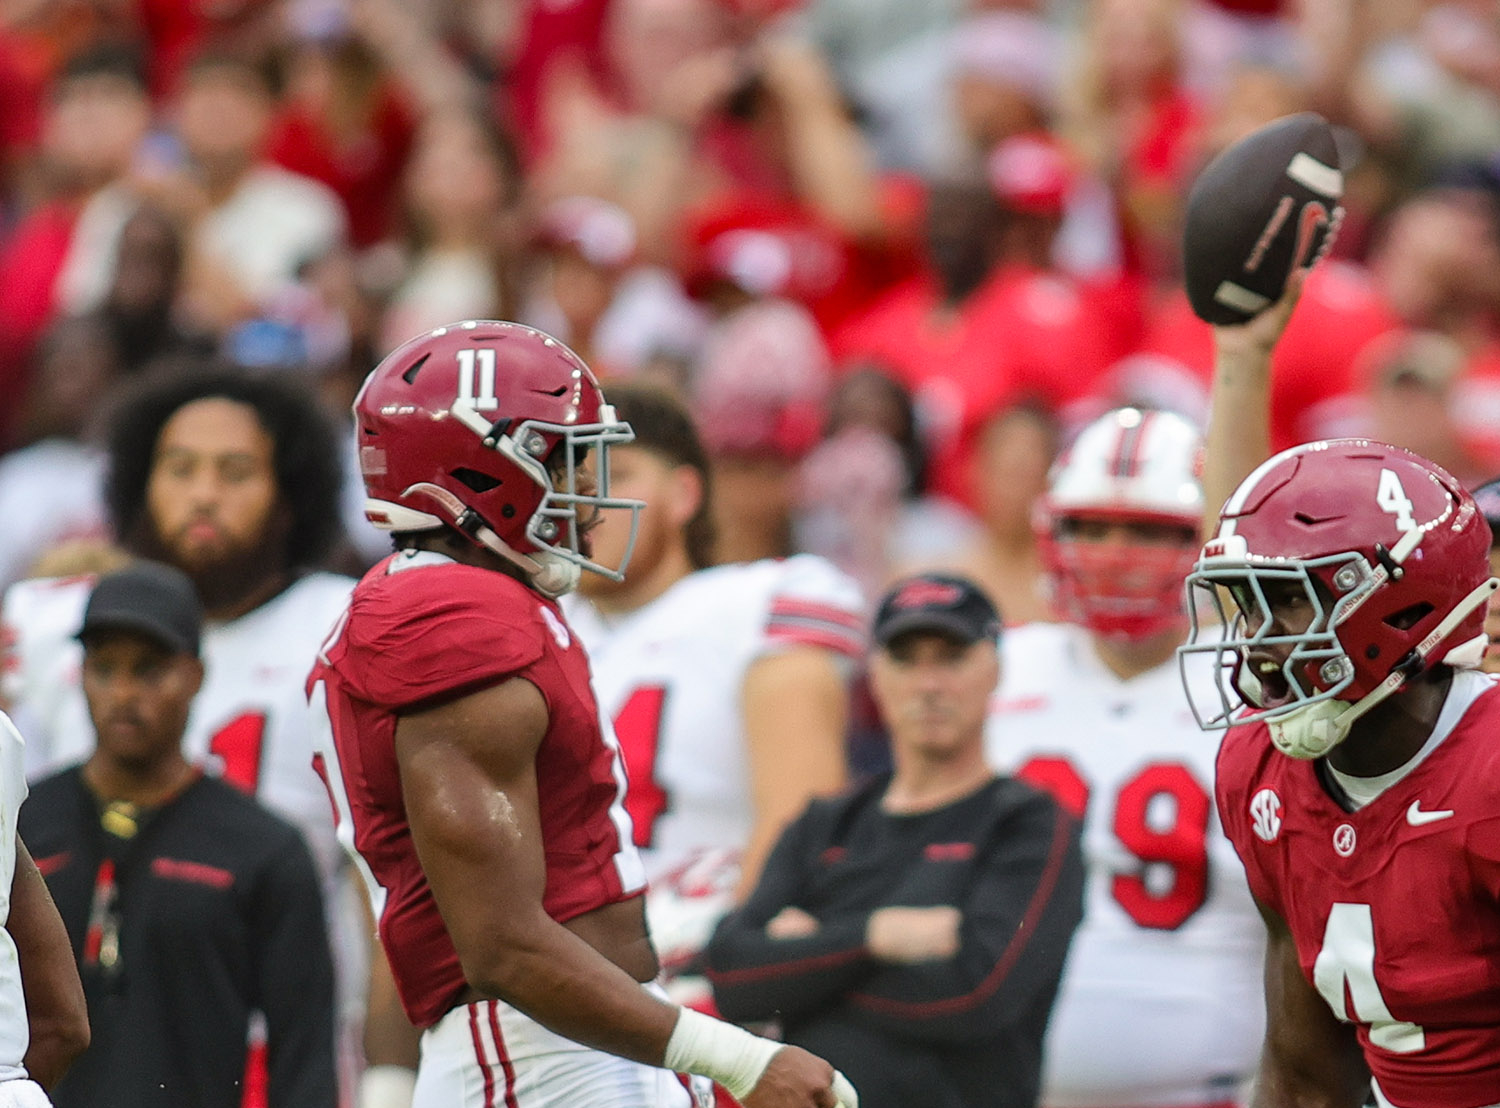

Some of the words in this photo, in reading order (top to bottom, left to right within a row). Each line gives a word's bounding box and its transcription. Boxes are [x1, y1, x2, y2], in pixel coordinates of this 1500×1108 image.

[456, 348, 499, 411] 11
[1377, 468, 1417, 532] 4
[1248, 787, 1282, 842] SEC
[1313, 901, 1427, 1054] 4
